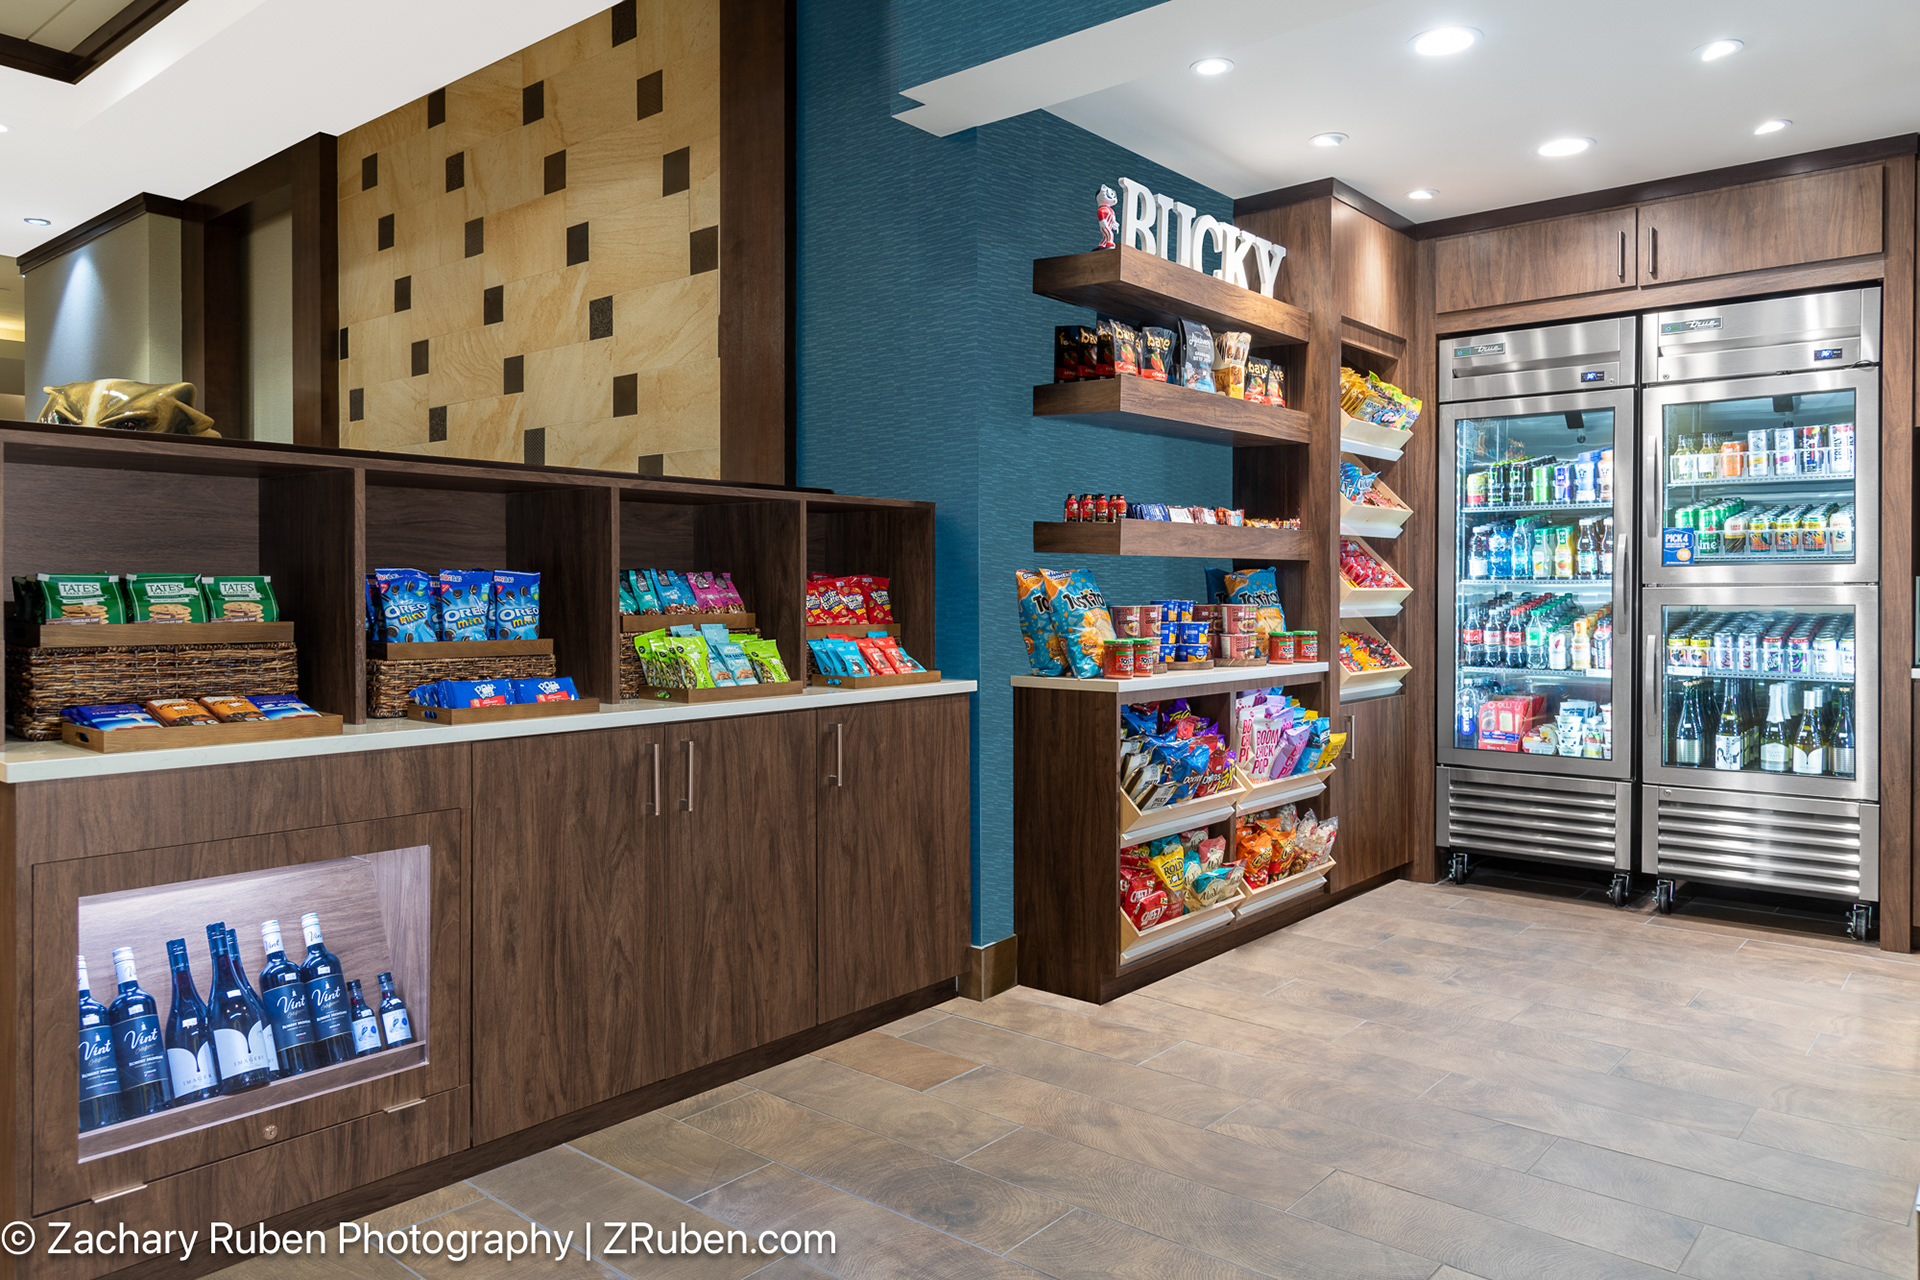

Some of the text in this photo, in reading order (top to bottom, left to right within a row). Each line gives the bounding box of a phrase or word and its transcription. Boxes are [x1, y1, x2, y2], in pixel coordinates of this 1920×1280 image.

[1118, 177, 1287, 299] BUCKY
[1146, 331, 1171, 350] bare
[1665, 534, 1682, 542] PICK
[61, 584, 99, 593] TATE'S
[147, 584, 184, 592] TATE'S
[222, 583, 254, 592] TATE'S
[384, 603, 427, 618] OREO
[399, 610, 425, 625] mini
[444, 607, 487, 622] OREO
[499, 607, 539, 622] OREO
[457, 617, 482, 629] min
[1256, 729, 1279, 746] BOOM
[1255, 745, 1276, 758] CHICK
[1252, 759, 1269, 774] POP
[1163, 861, 1183, 876] ROLD
[277, 994, 305, 1013] Vint
[311, 986, 341, 1007] Vint
[123, 1028, 158, 1050] Vint
[78, 1039, 112, 1061] Vint
[183, 1074, 213, 1086] IMAGER
